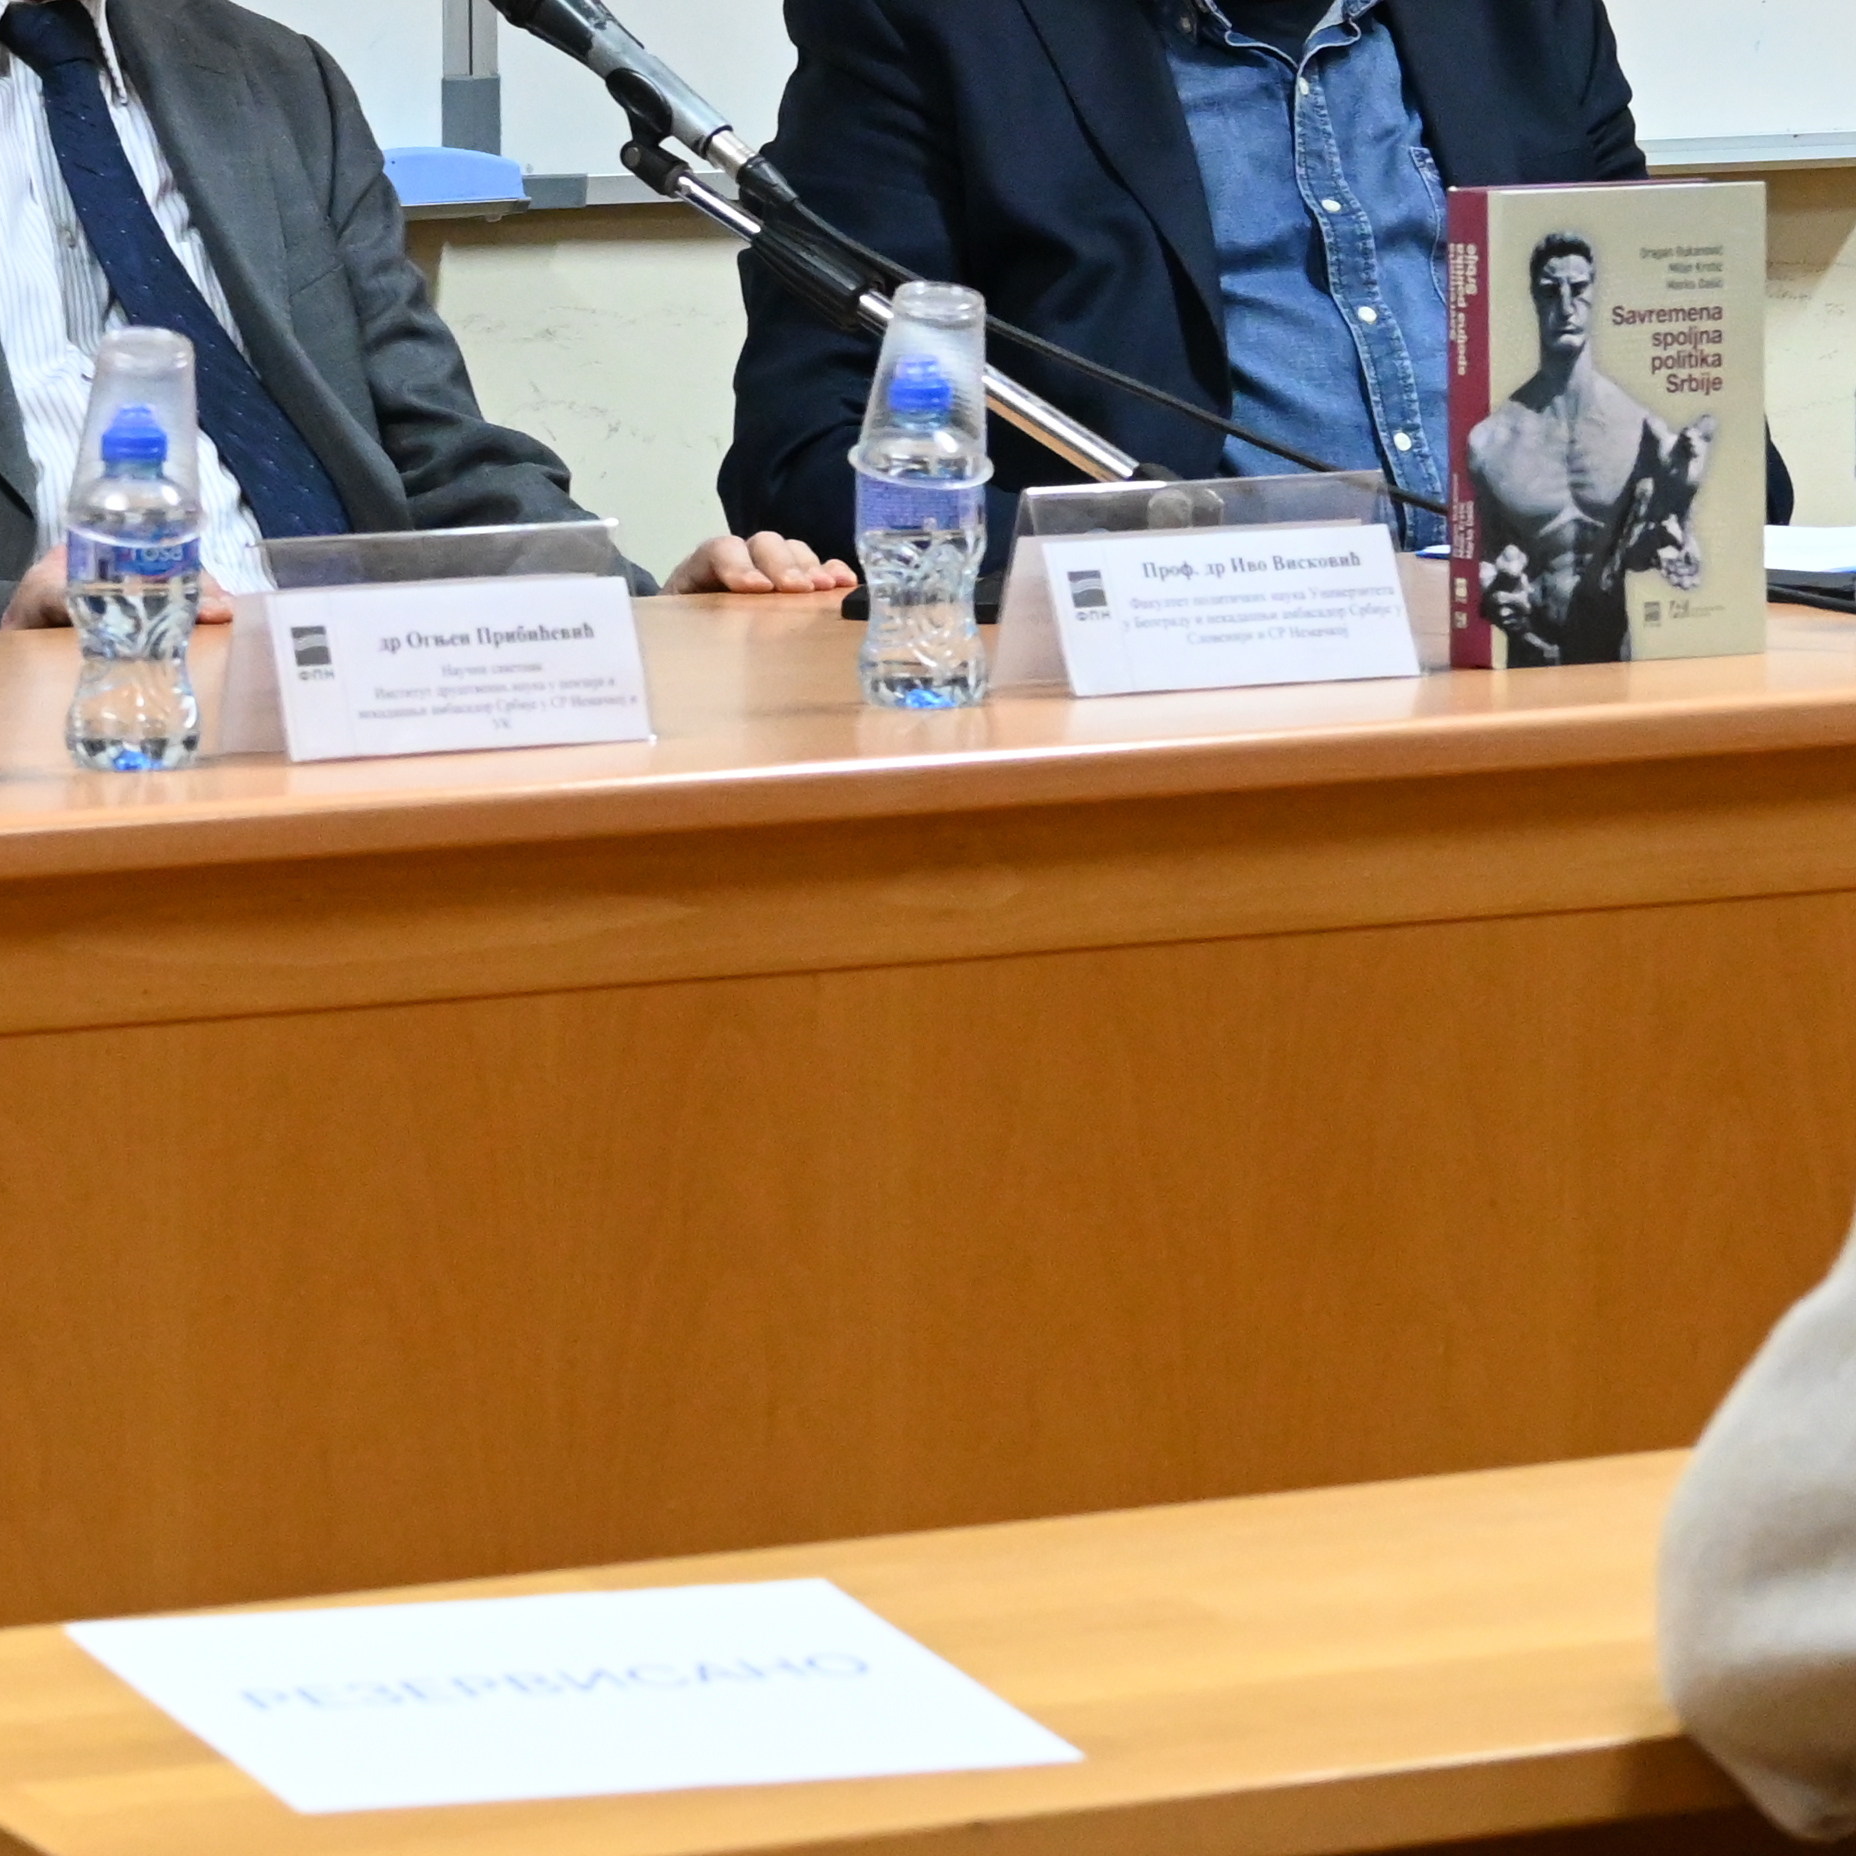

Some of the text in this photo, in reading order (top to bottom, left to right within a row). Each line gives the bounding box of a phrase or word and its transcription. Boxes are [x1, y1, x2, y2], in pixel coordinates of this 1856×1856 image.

[1612, 305, 1723, 326] Savremena
[1652, 326, 1723, 351] spoljna
[1651, 349, 1722, 374] politika
[1666, 372, 1723, 396] Srbije
[1142, 551, 1361, 581] Проф. др Иво Висковић
[377, 622, 595, 655] др Огњен Прибићевић
[238, 1647, 872, 1714] РЕЗЕРВИСАНО
